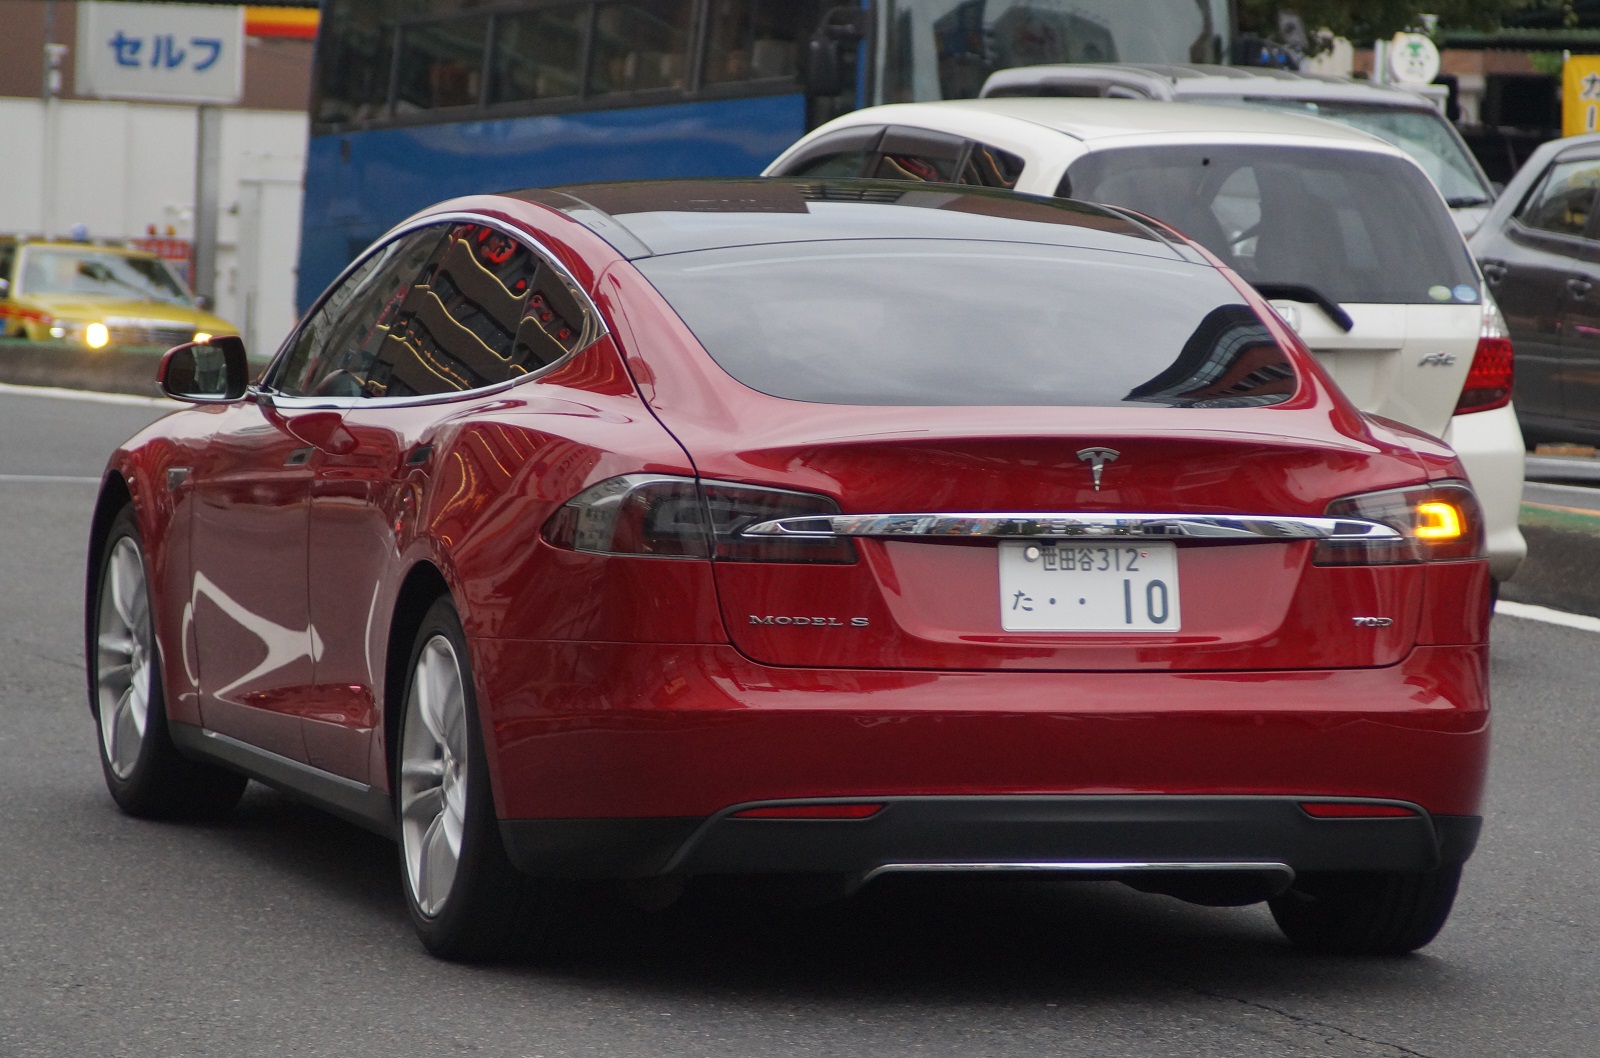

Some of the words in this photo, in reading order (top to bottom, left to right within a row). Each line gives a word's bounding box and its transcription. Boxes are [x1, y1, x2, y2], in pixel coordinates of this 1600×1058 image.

[109, 31, 222, 72] セルフ
[748, 615, 844, 626] MODEL
[850, 617, 870, 627] S
[1351, 616, 1394, 627] 70D
